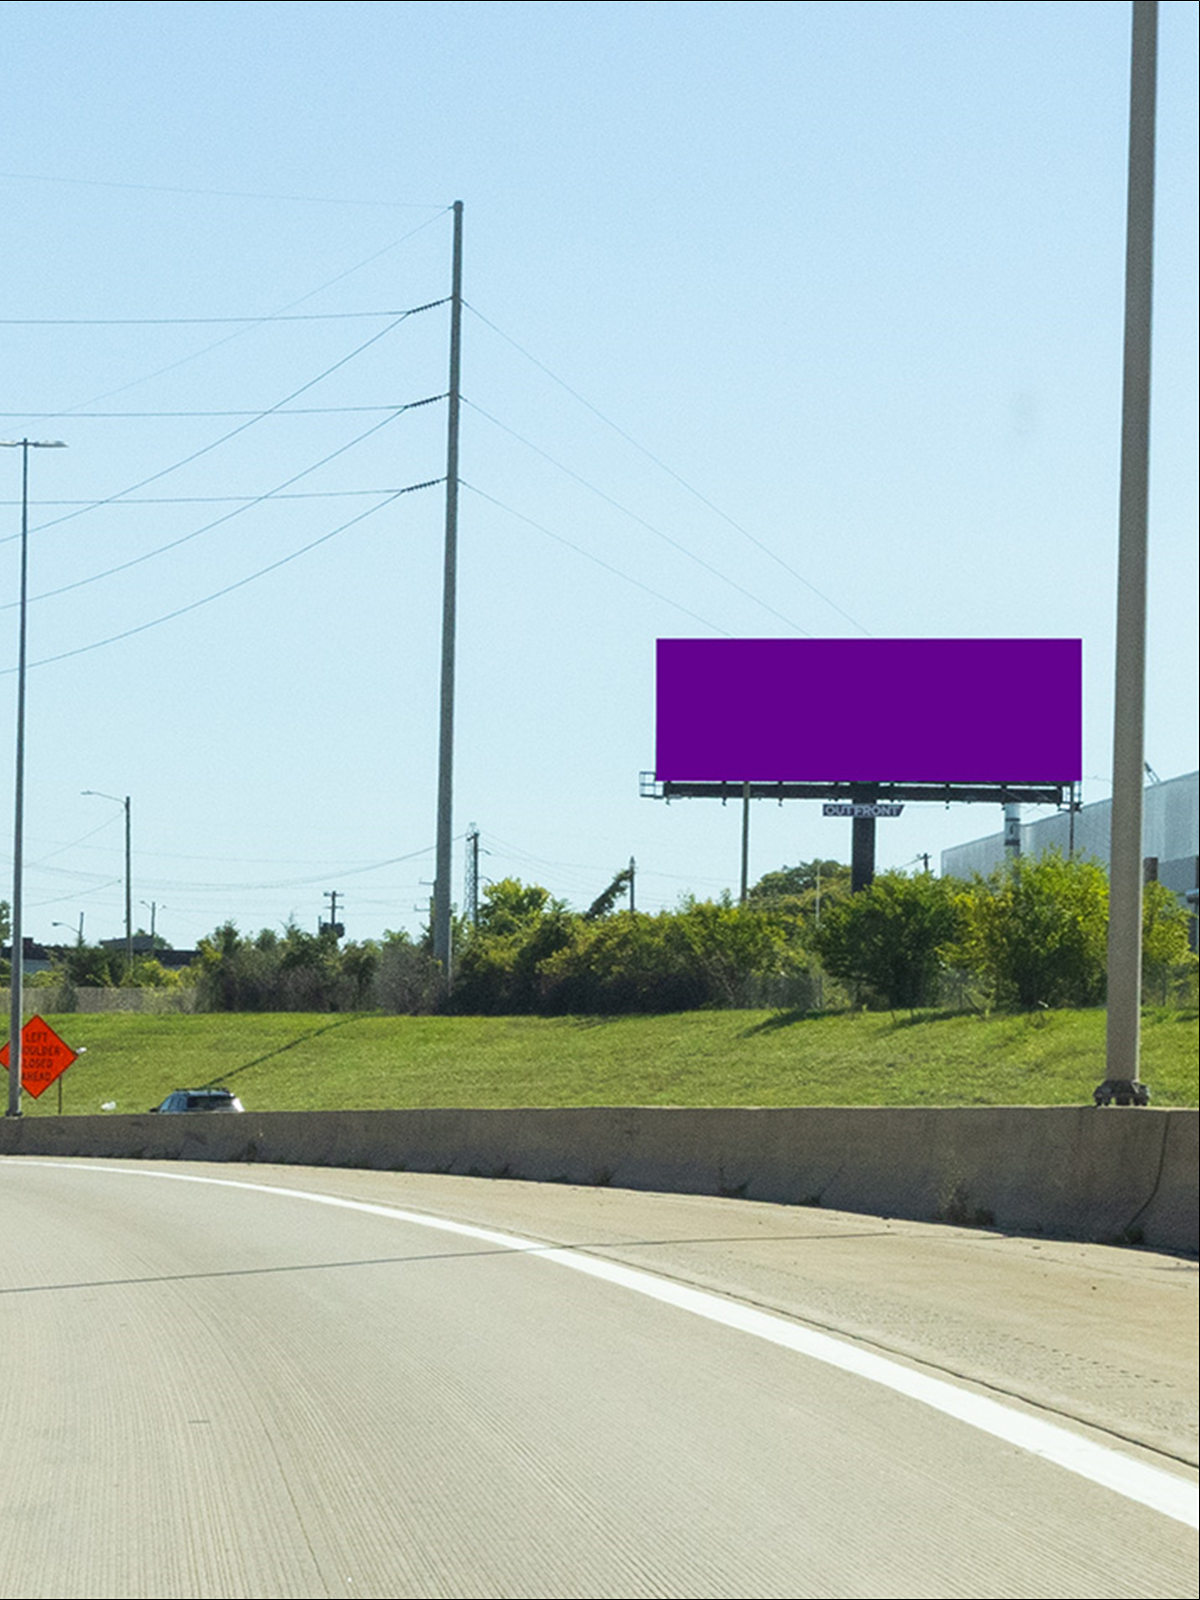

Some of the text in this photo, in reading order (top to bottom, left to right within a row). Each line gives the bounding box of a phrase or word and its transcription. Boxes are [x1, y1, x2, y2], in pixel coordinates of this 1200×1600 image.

[825, 805, 900, 816] OUTFRONT
[25, 1032, 48, 1043] LEFT
[22, 1046, 61, 1056] OULDER
[22, 1058, 53, 1069] LOSED
